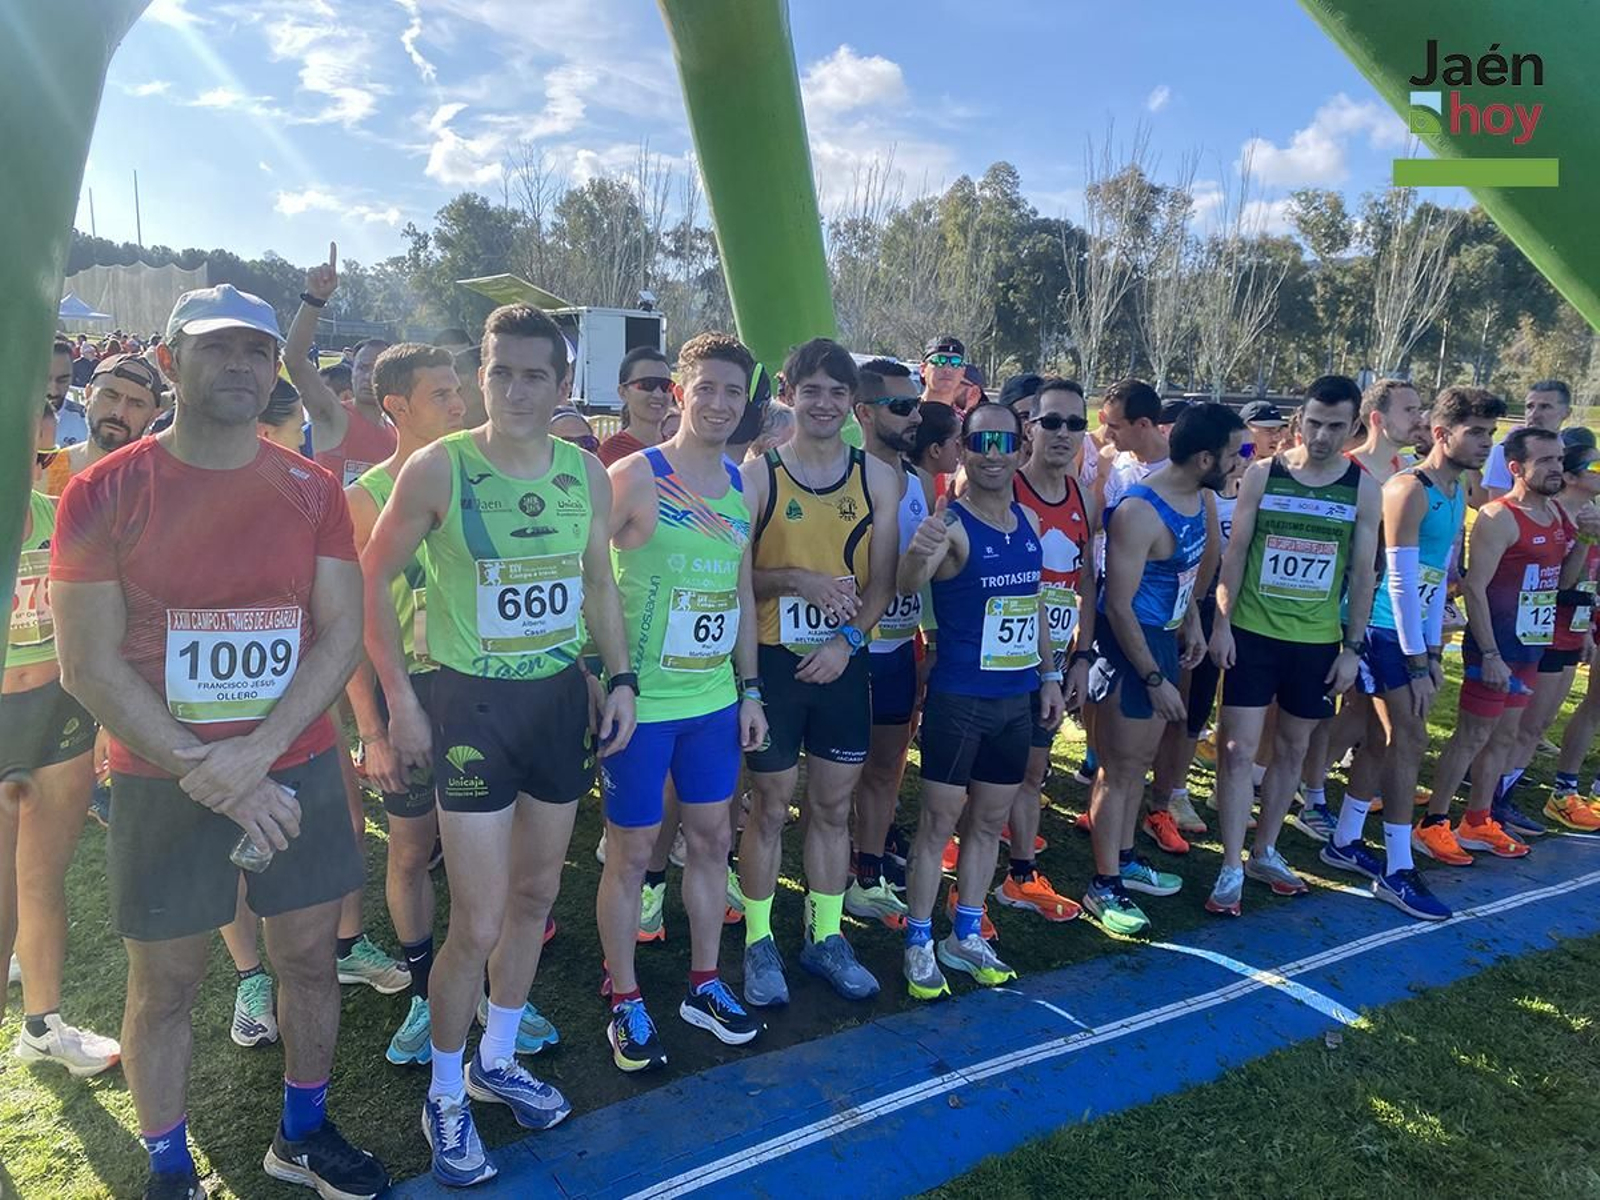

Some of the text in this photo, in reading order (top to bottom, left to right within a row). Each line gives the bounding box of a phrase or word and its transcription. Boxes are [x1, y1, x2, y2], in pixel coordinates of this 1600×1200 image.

[1269, 554, 1331, 580] 1077
[497, 582, 568, 621] 660
[885, 594, 921, 617] 054
[191, 611, 219, 630] CAMPO
[220, 611, 227, 630] A
[254, 610, 265, 630] DE
[264, 610, 274, 629] LA
[274, 608, 297, 629] GARZA
[694, 613, 725, 643] 63
[998, 616, 1035, 643] 573
[1045, 606, 1071, 630] 90
[179, 638, 292, 680] 1009
[198, 680, 276, 690] FRANCISCO JESUS
[217, 690, 258, 701] OLLERO
[448, 776, 485, 787] Unicaja
